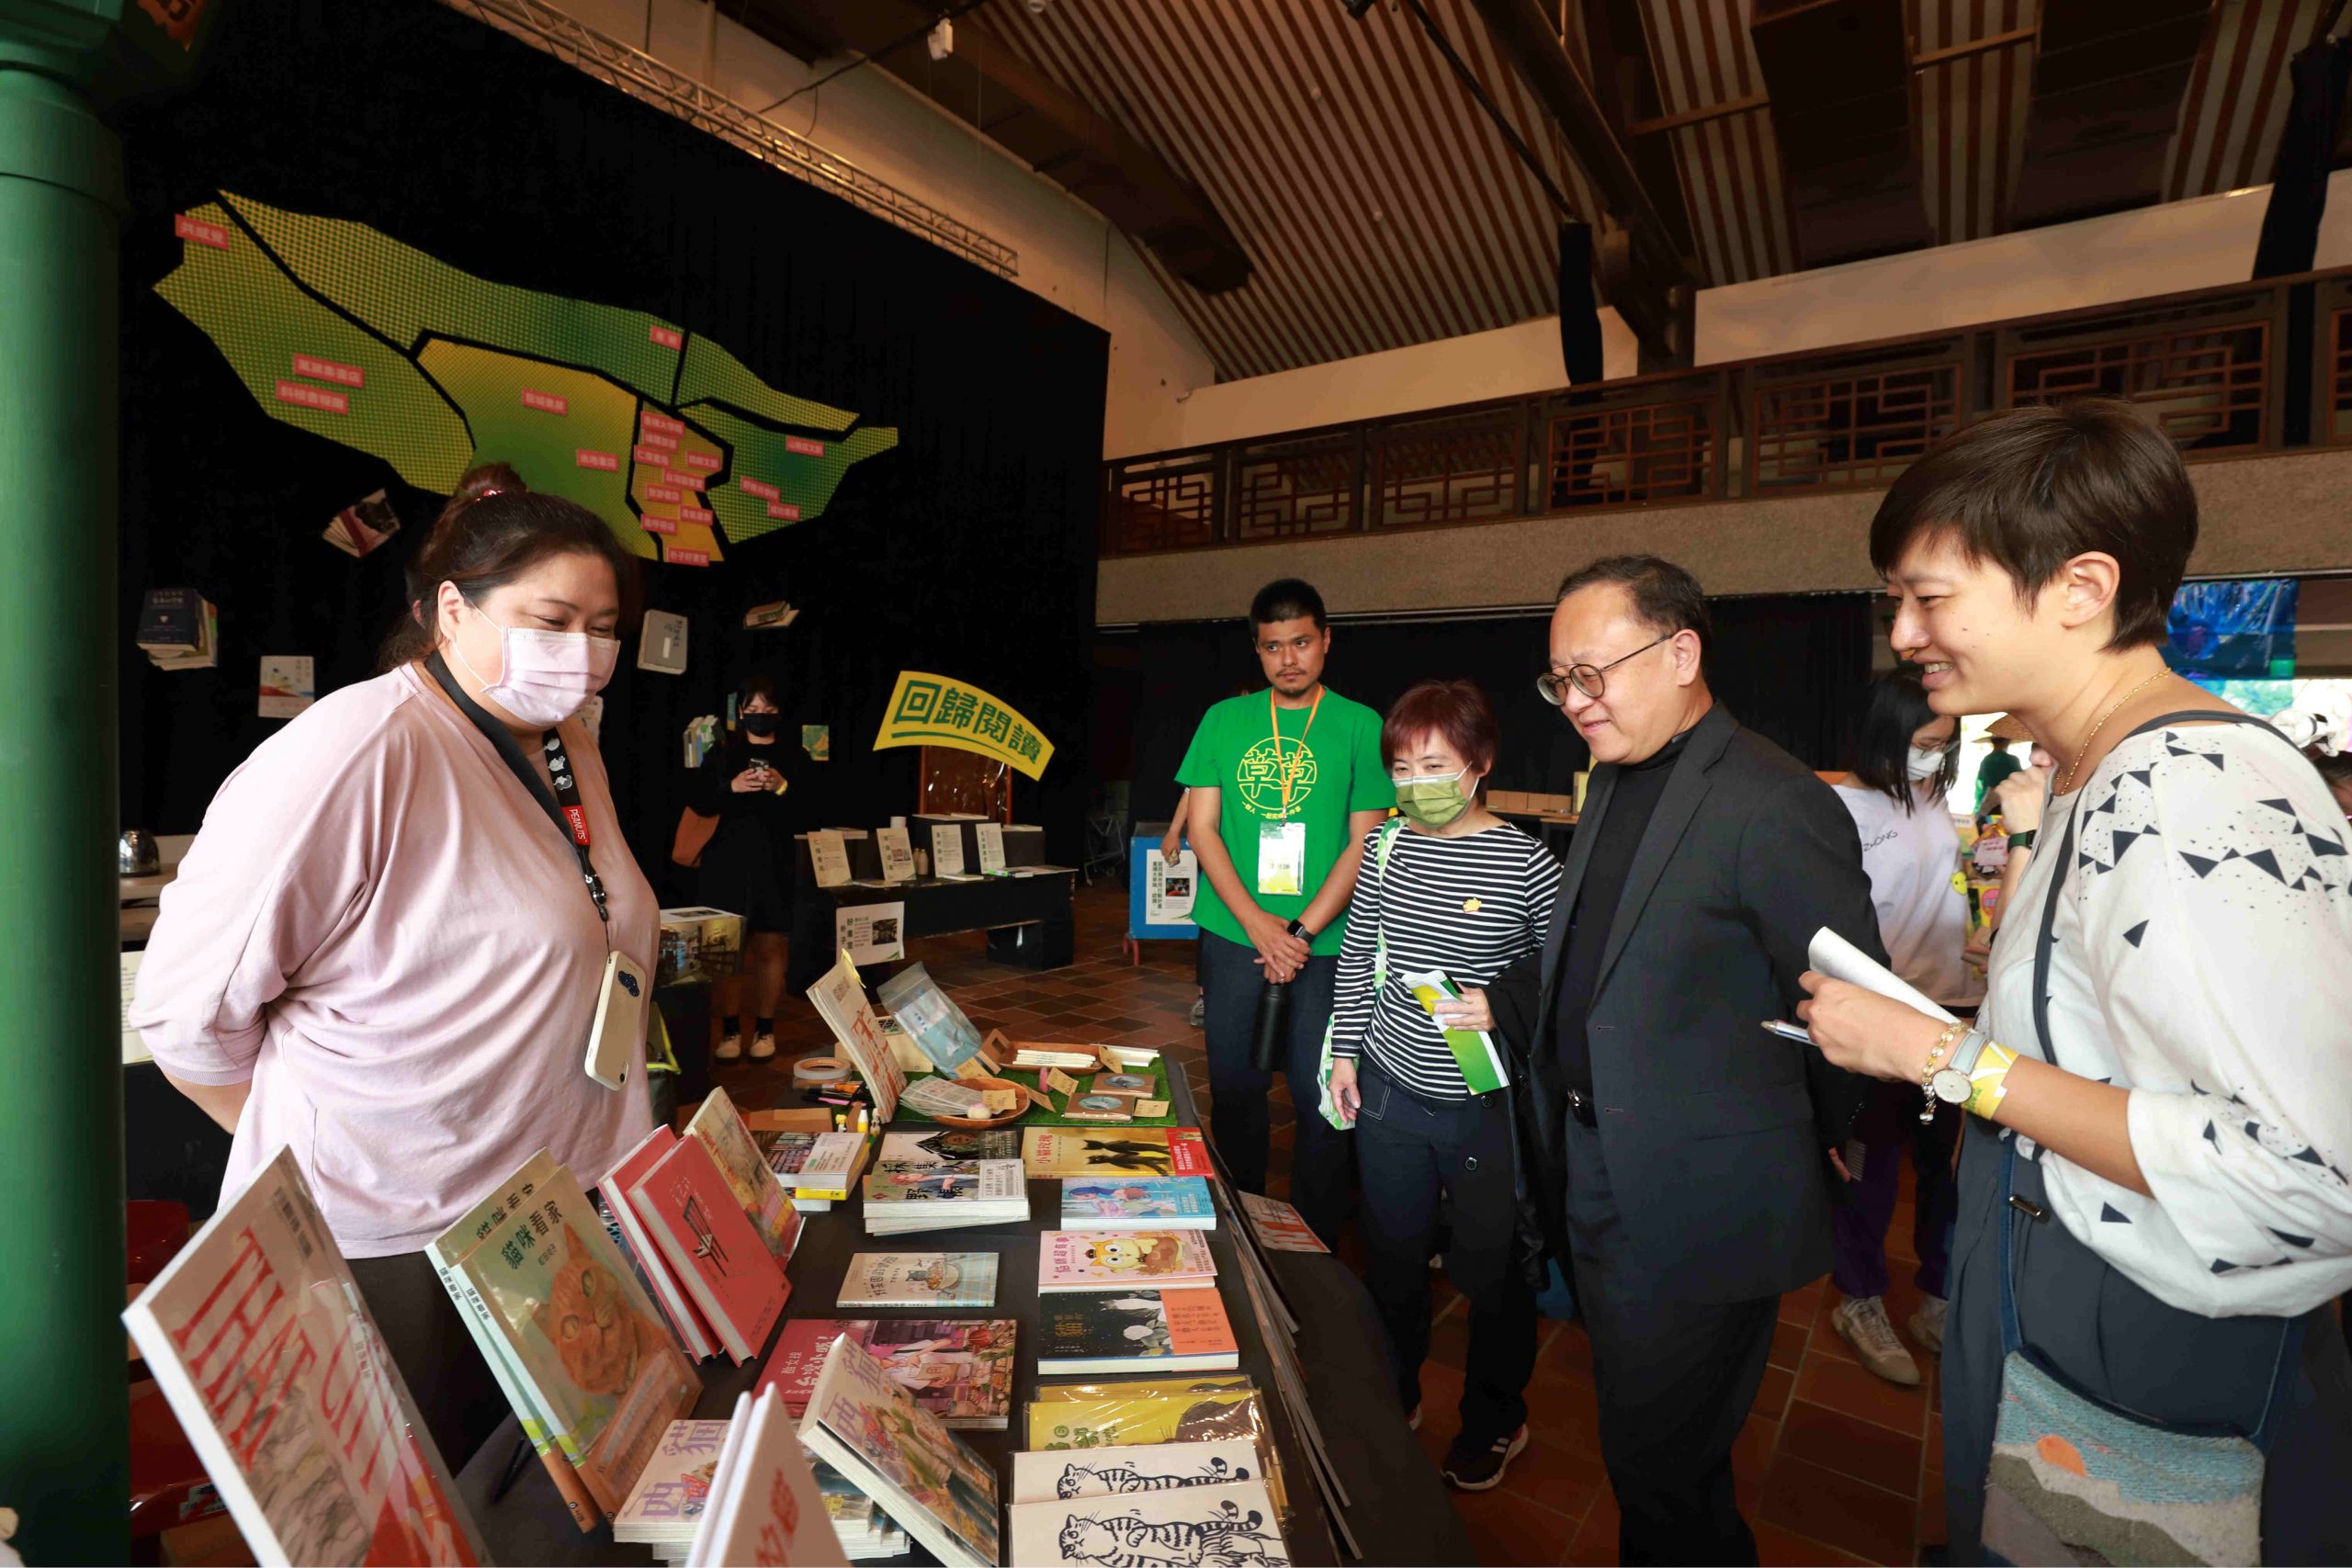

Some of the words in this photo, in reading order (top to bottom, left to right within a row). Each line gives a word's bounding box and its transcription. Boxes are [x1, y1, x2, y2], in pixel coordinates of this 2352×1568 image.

[892, 680, 1043, 764] 回歸閱讀
[568, 807, 587, 842] PEANUTS
[1035, 1134, 1054, 1165] 小貓玫瑰
[502, 1200, 563, 1269] 貓咪看家
[171, 1225, 318, 1470] THAT
